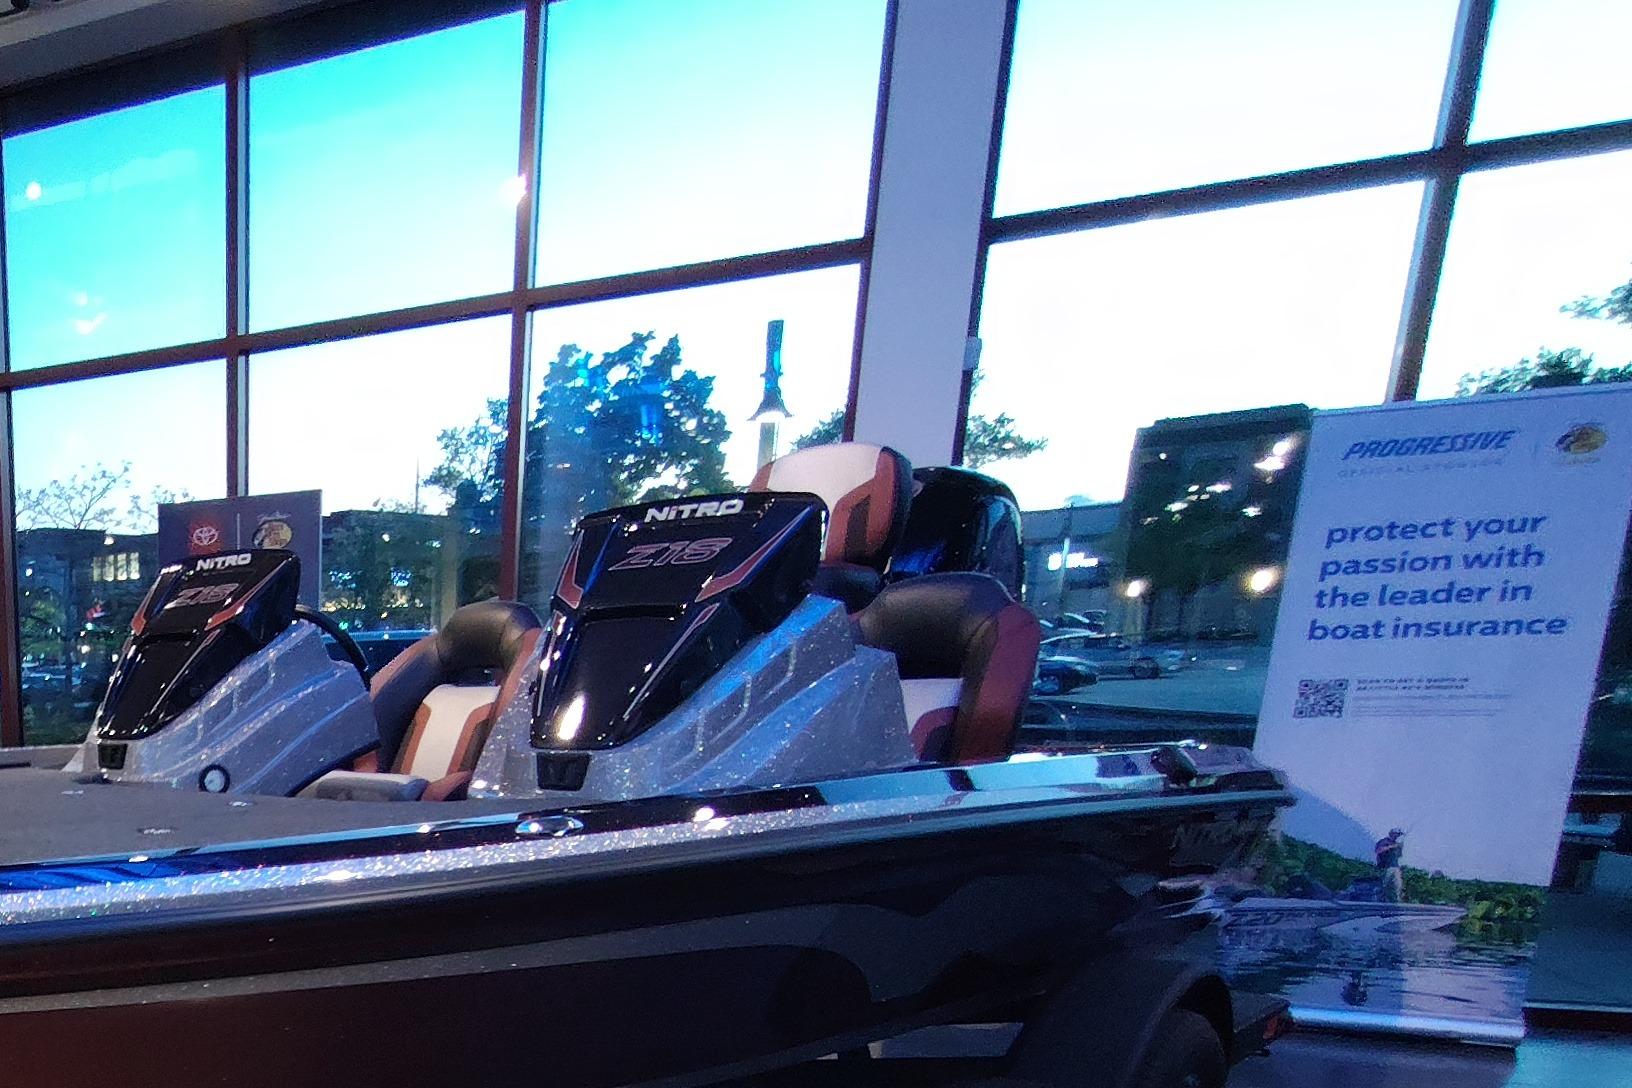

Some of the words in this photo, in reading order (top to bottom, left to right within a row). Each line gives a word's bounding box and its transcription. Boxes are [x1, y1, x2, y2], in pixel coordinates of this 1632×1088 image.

[1341, 430, 1516, 461] PROGRESSIVE
[1325, 517, 1456, 550] protect
[1463, 514, 1547, 543] your
[1318, 550, 1452, 583] passion
[1461, 543, 1544, 570] with
[1315, 585, 1370, 609] the
[1376, 580, 1490, 607] leader
[1497, 578, 1533, 602] in
[1308, 618, 1386, 641] boat
[1391, 615, 1567, 639] insurance
